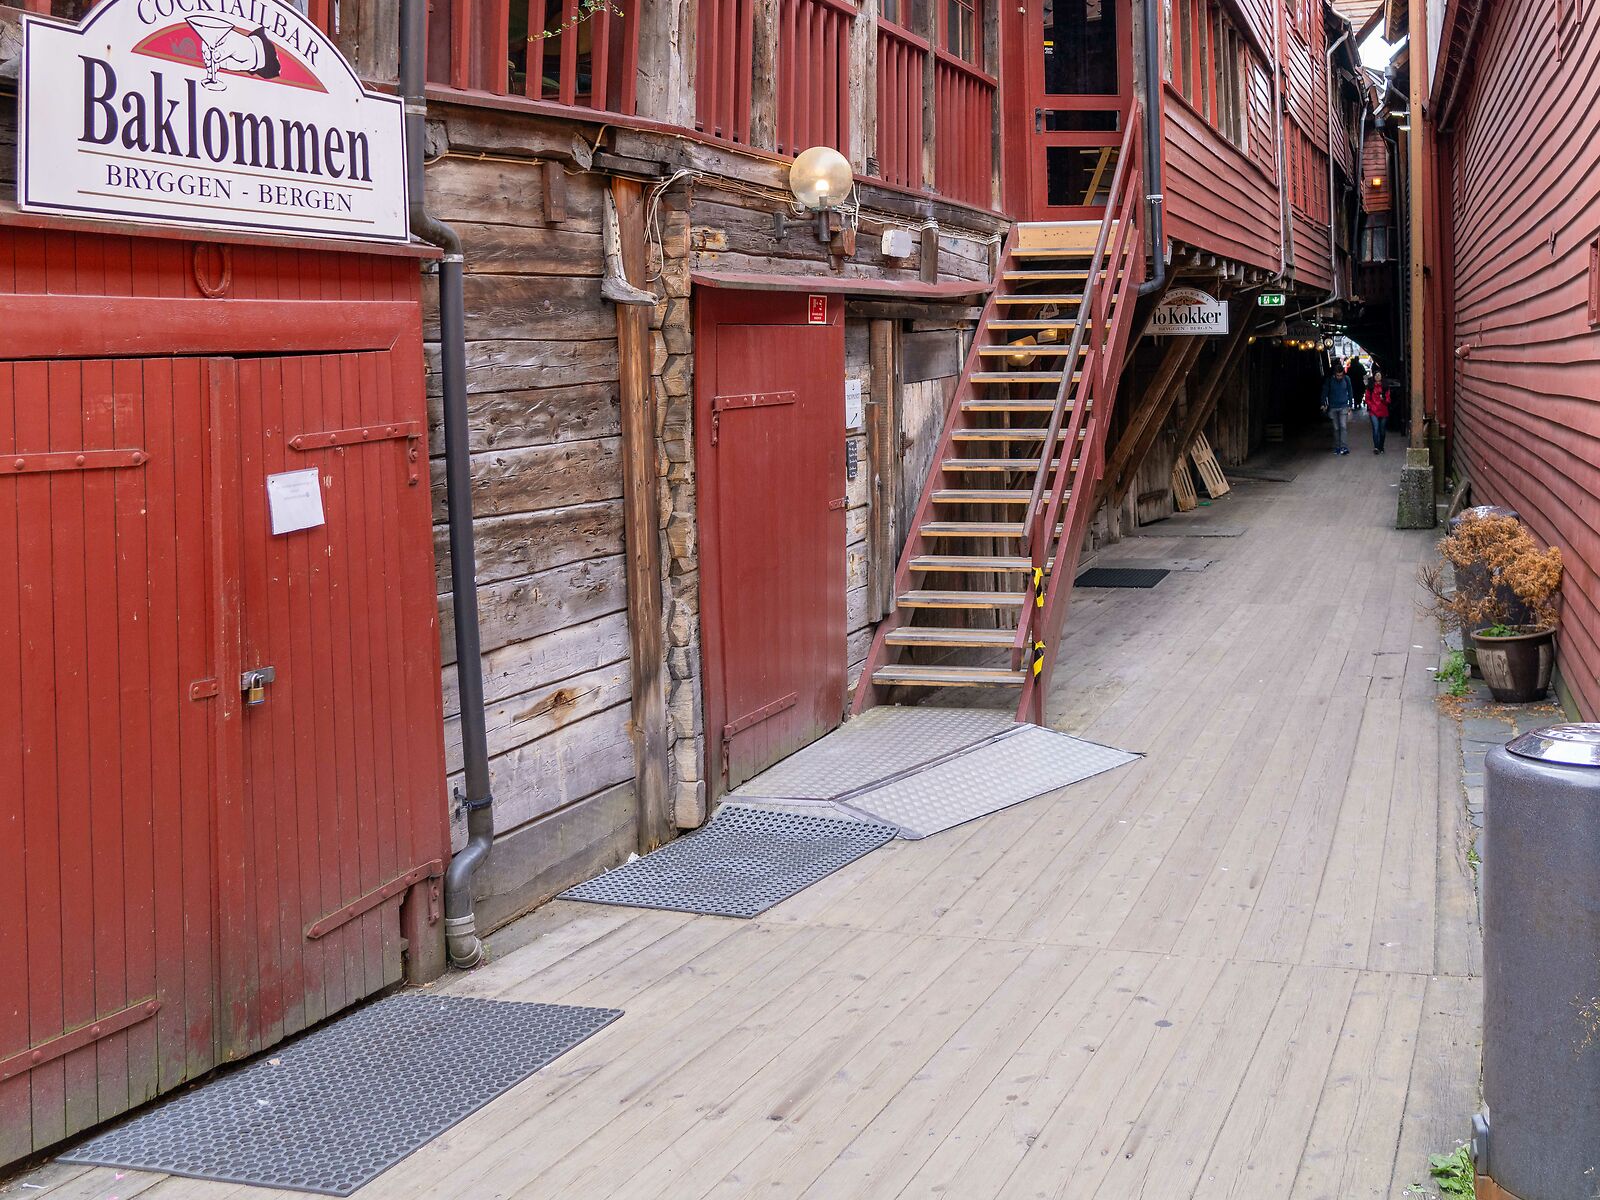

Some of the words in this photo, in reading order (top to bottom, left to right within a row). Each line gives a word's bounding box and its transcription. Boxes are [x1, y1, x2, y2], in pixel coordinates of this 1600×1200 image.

[77, 54, 373, 183] Baklommen
[105, 164, 232, 200] BRYGGEN
[258, 184, 353, 213] BERGEN
[1169, 307, 1221, 324] Kokker
